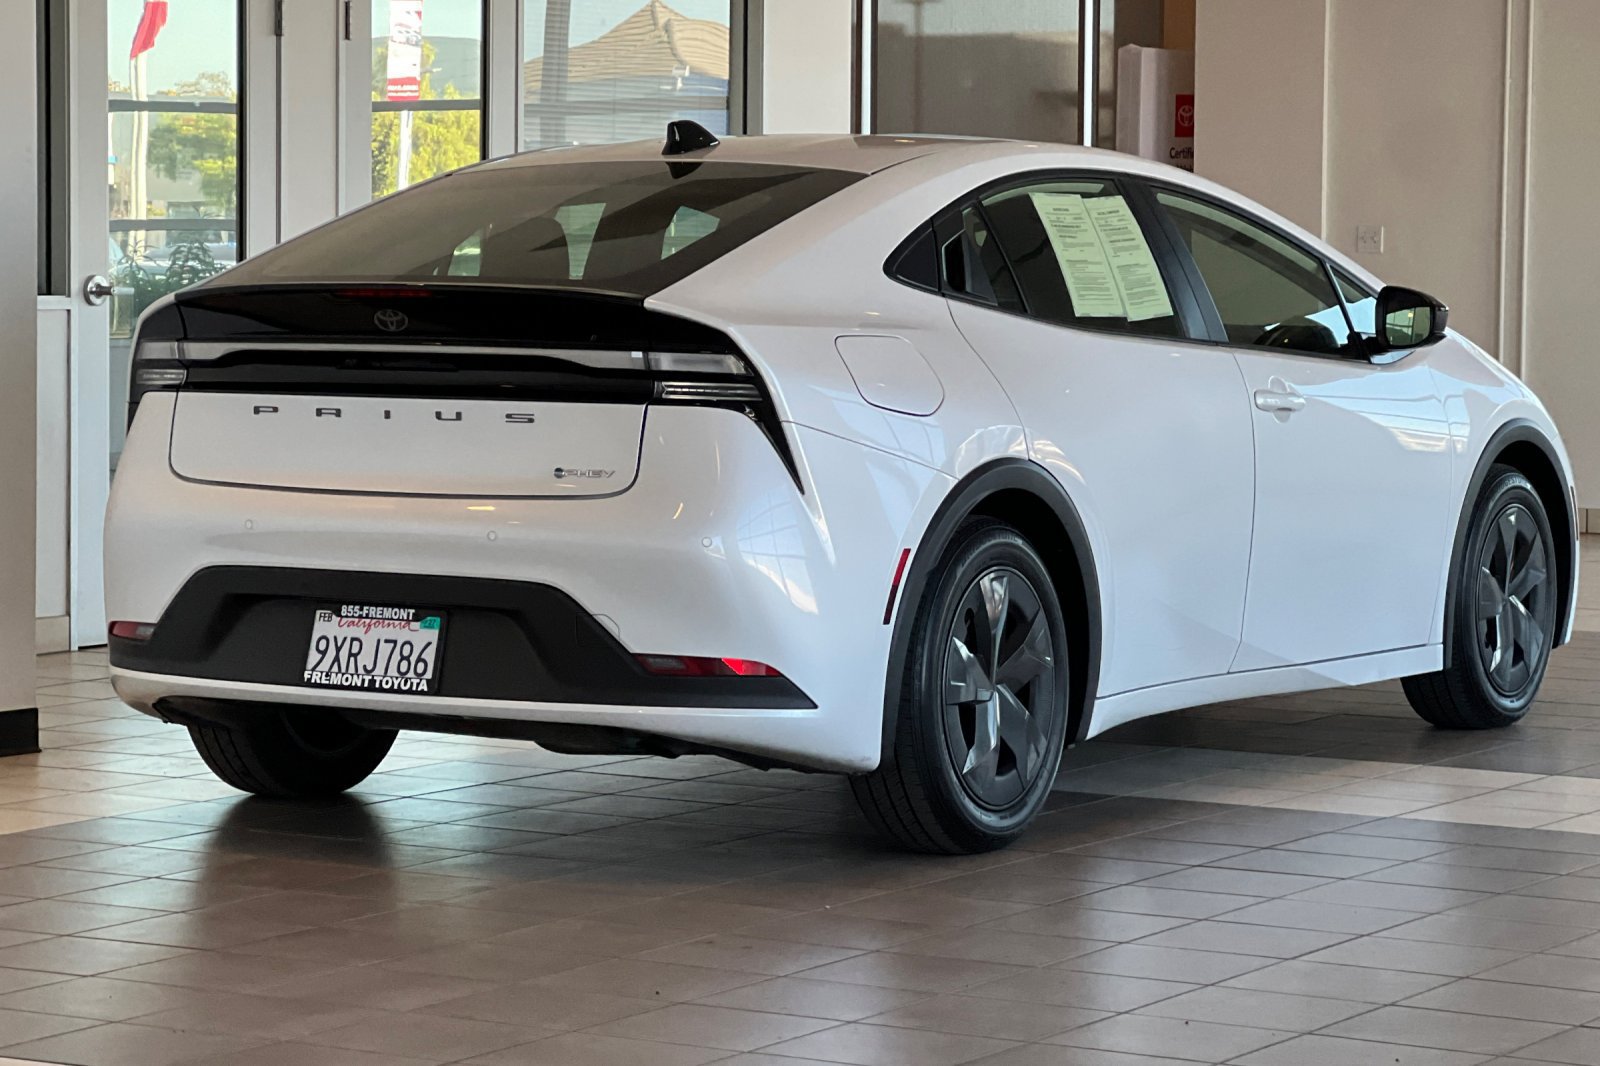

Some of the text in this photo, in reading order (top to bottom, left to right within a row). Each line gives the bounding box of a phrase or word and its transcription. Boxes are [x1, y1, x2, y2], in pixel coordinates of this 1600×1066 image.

[253, 405, 535, 424] PRIUS
[318, 612, 334, 623] FEB
[341, 604, 415, 620] 855-FREMONT
[338, 617, 419, 634] California
[311, 635, 432, 678] 9XRJ786
[304, 670, 429, 692] FREMONT TOYOTA
